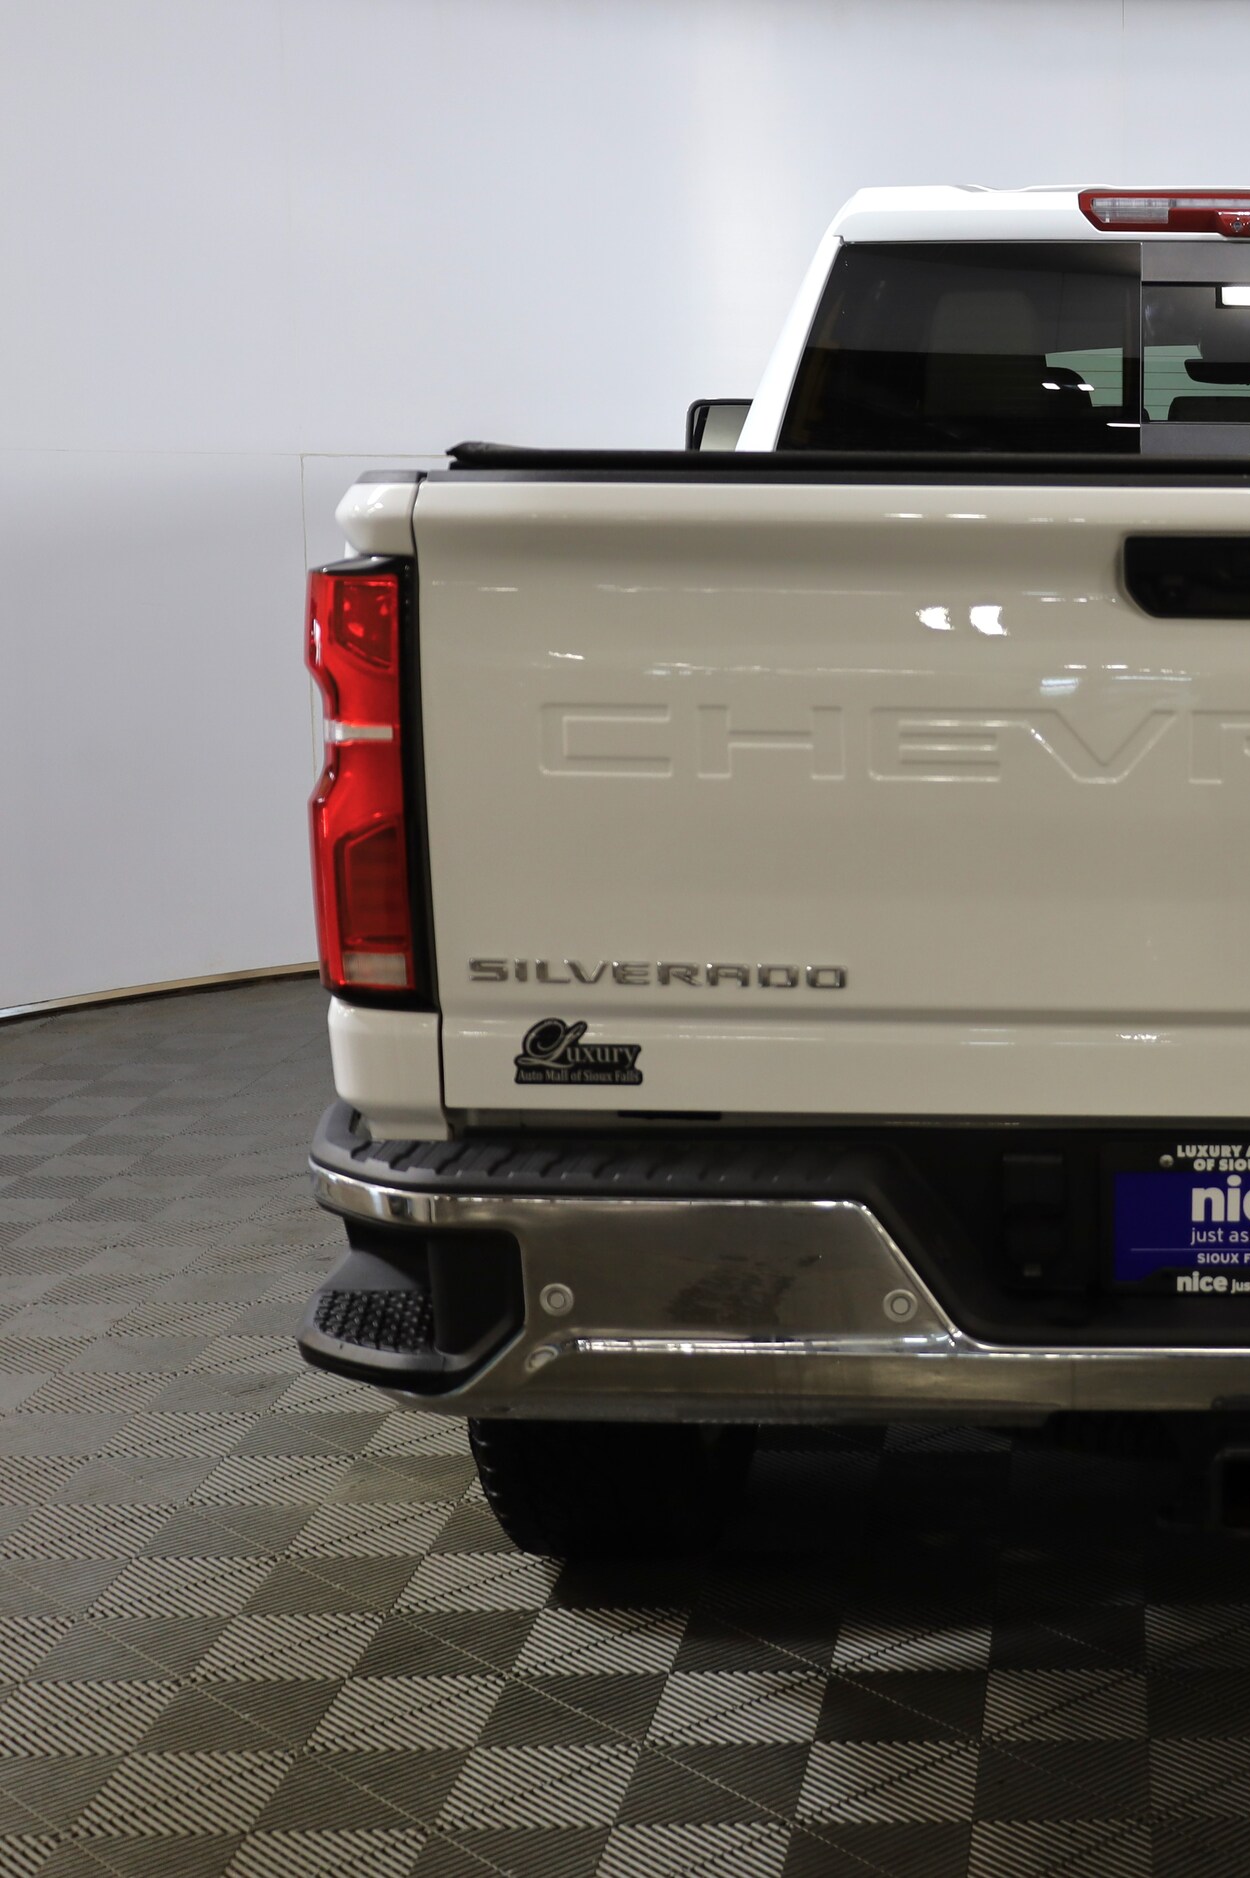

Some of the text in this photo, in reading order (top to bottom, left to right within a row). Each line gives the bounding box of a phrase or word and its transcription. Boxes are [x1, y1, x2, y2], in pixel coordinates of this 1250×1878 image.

[468, 957, 849, 989] SILVERADO
[516, 1019, 638, 1069] Luxury
[518, 1069, 640, 1083] Auto Mall of Sioux Falls
[1176, 1144, 1243, 1158] LUXURY
[1193, 1158, 1216, 1171] OF
[1190, 1227, 1224, 1245] just
[1196, 1252, 1239, 1264] SIOUX
[1176, 1271, 1228, 1292] nice
